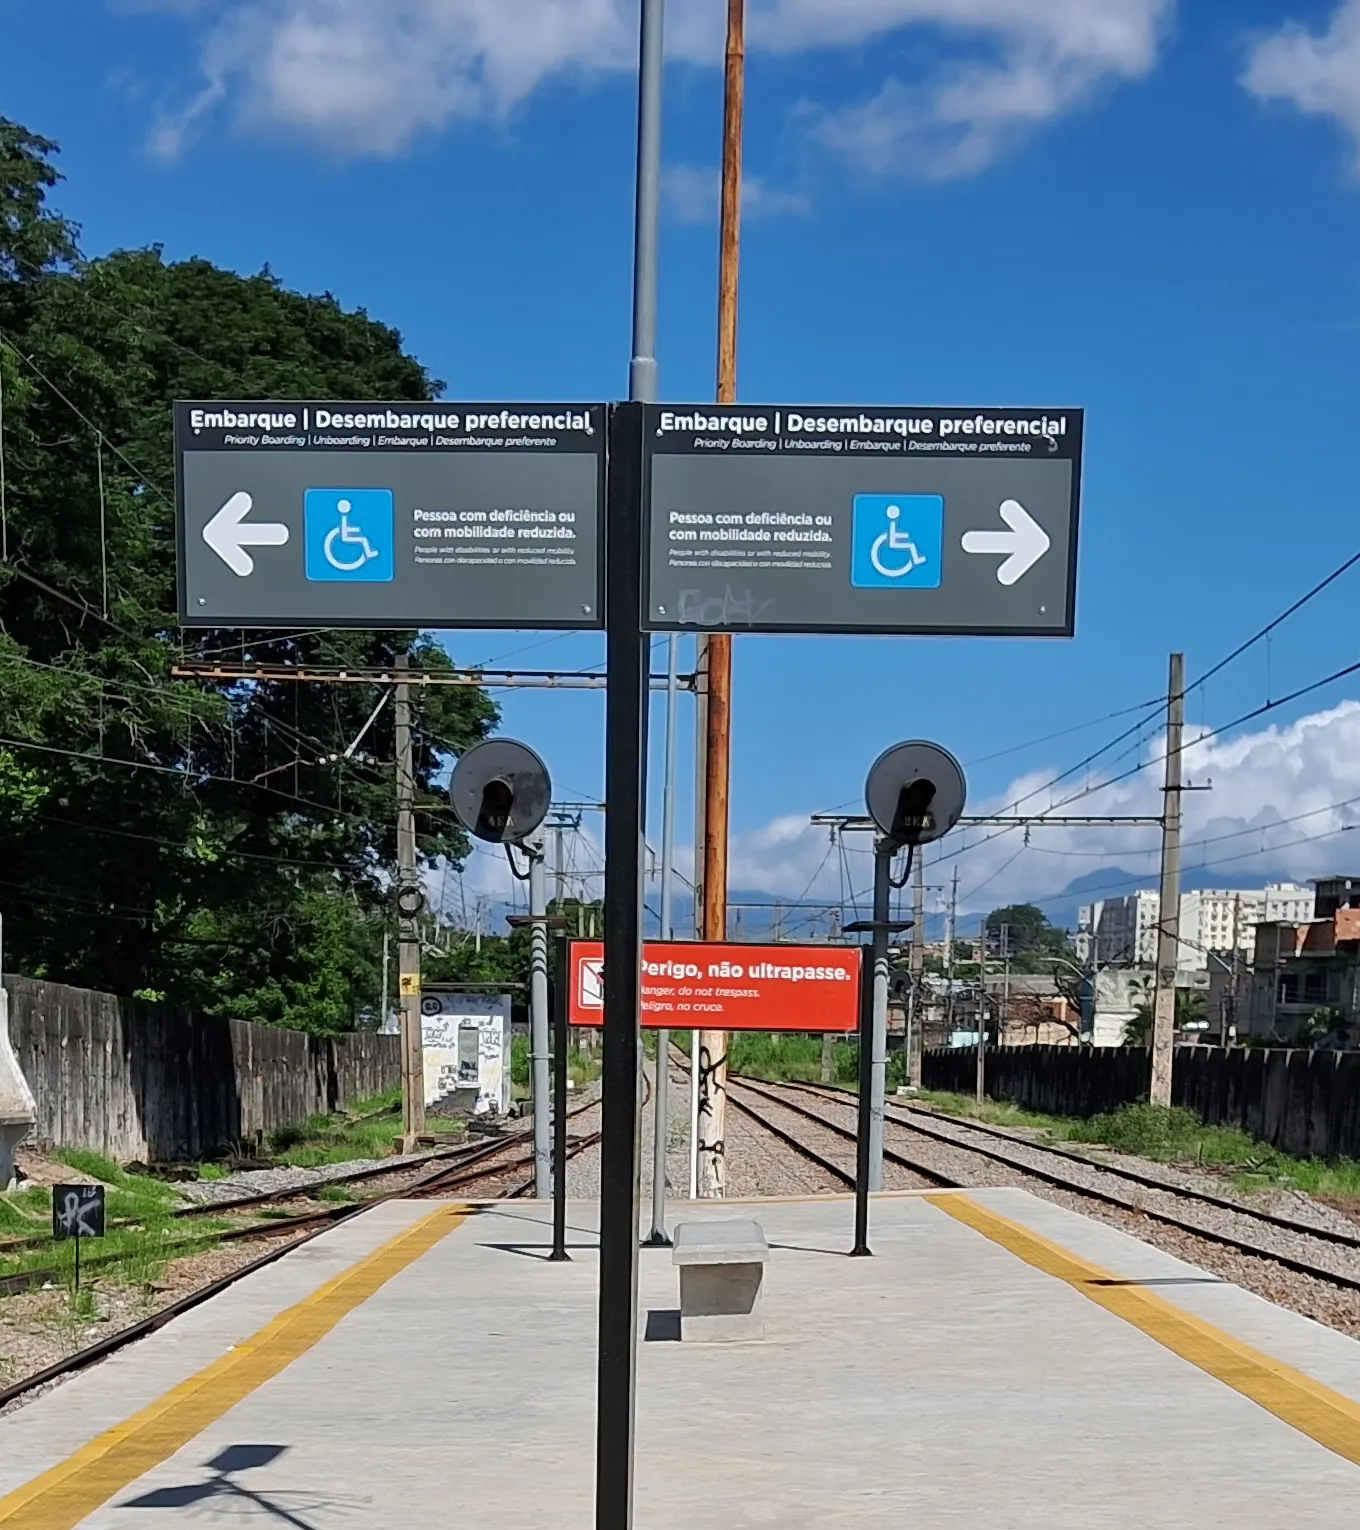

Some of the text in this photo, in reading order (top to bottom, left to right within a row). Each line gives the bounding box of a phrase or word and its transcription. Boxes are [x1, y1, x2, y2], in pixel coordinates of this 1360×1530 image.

[191, 409, 591, 432] Embarque Desembarque preferencial
[660, 412, 1067, 437] Embarque Desembarque preferencial
[224, 434, 557, 448] Priority Boarding Unboarding Embarque Desembarque preferente
[694, 437, 1032, 453] Priority Boarding Unboarding Embarque Desembarque preferente
[413, 509, 576, 523] Pessoa com deficiência ou
[669, 511, 832, 526] Pessoa com deficiência ou
[413, 525, 577, 539] com mobilidade reduzida.
[669, 529, 833, 542] com mobilidade reduzida.
[708, 961, 744, 978] não
[748, 963, 851, 982] ultrapasse.
[678, 986, 693, 996] do
[694, 987, 713, 997] not
[715, 988, 761, 999] trespass.
[677, 1003, 691, 1012] no
[693, 1003, 724, 1013] cruce.
